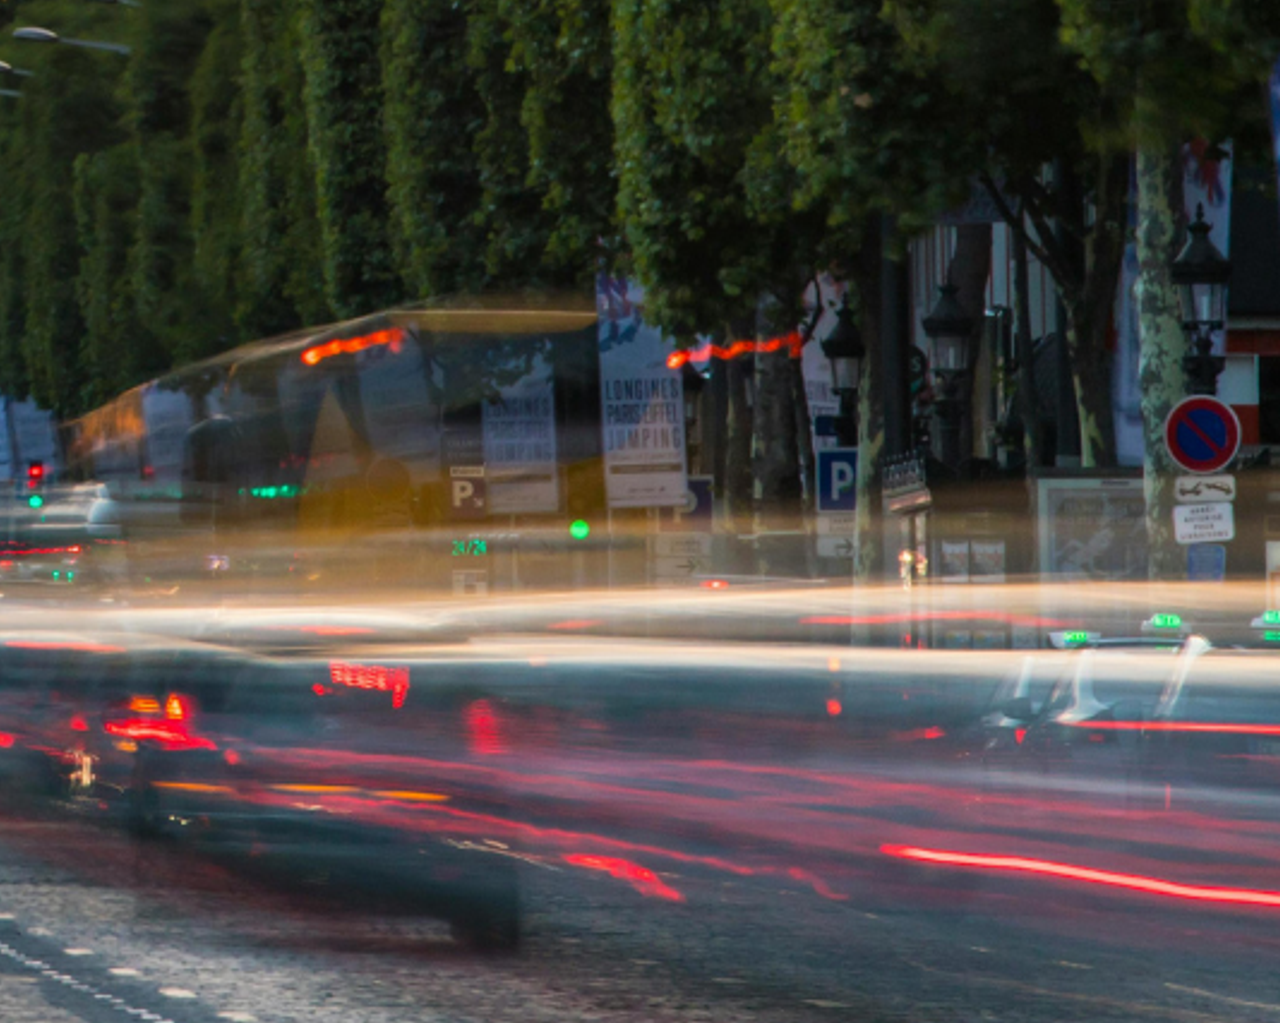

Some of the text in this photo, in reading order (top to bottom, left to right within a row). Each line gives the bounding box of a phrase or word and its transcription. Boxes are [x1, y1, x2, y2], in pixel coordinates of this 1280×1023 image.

[605, 377, 679, 400] LONGINES
[606, 402, 678, 425] PARIS EIFFEL
[607, 427, 681, 451] JUMPING
[831, 461, 854, 502] P
[452, 480, 475, 508] P
[452, 539, 487, 556] 24/24
